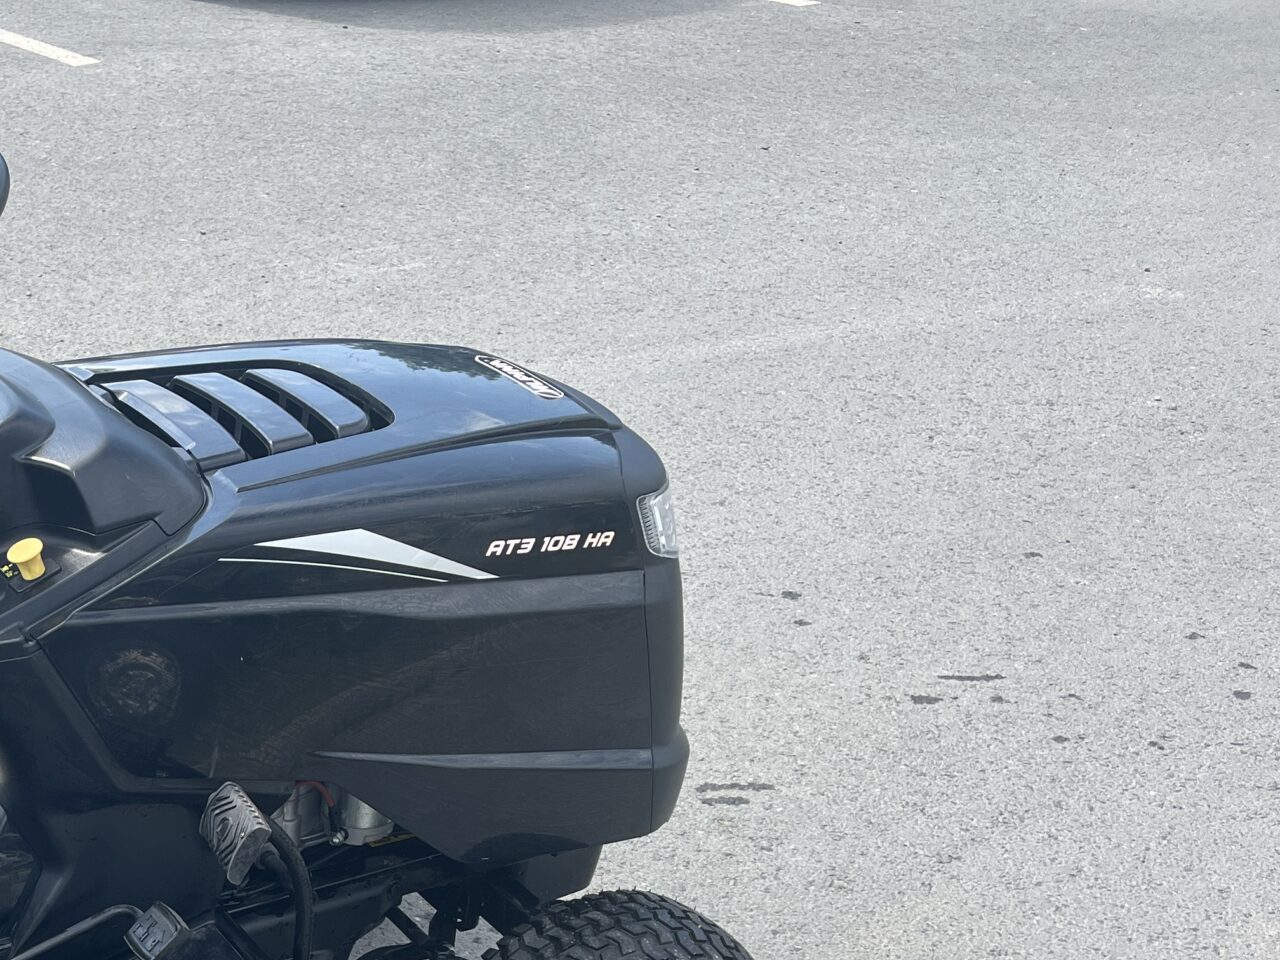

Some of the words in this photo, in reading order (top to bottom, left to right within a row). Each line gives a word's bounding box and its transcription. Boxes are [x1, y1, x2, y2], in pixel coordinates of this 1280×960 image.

[485, 537, 536, 557] AT3
[540, 533, 581, 553] 108
[583, 531, 615, 549] HA
